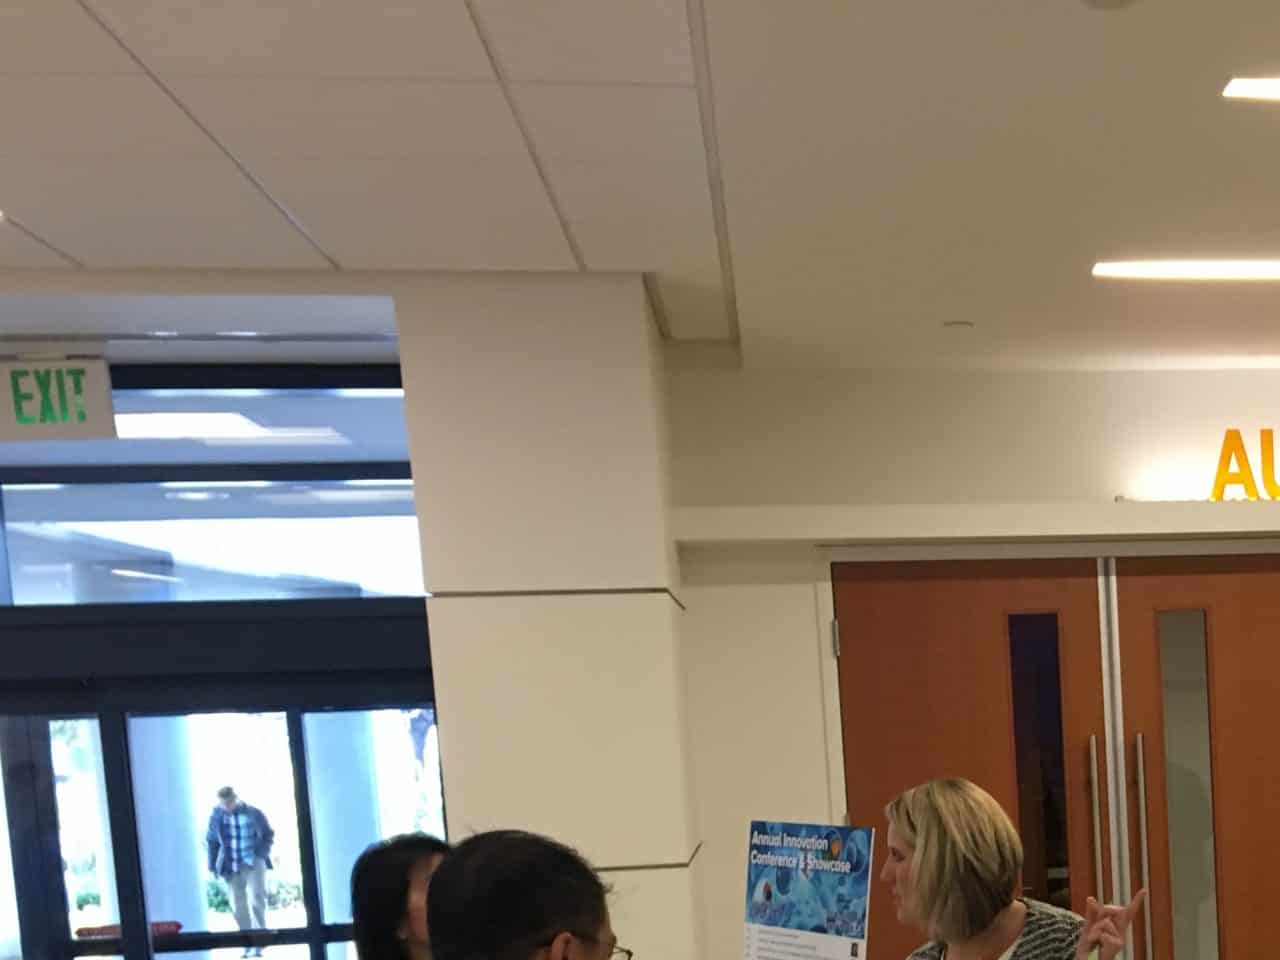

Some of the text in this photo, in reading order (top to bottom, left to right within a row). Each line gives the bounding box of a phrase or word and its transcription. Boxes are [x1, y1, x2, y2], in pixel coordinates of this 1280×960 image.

[10, 368, 86, 425] EXIT
[752, 830, 829, 850] Annual Innovation
[751, 850, 798, 867] Conference
[807, 855, 852, 873] Showcase
